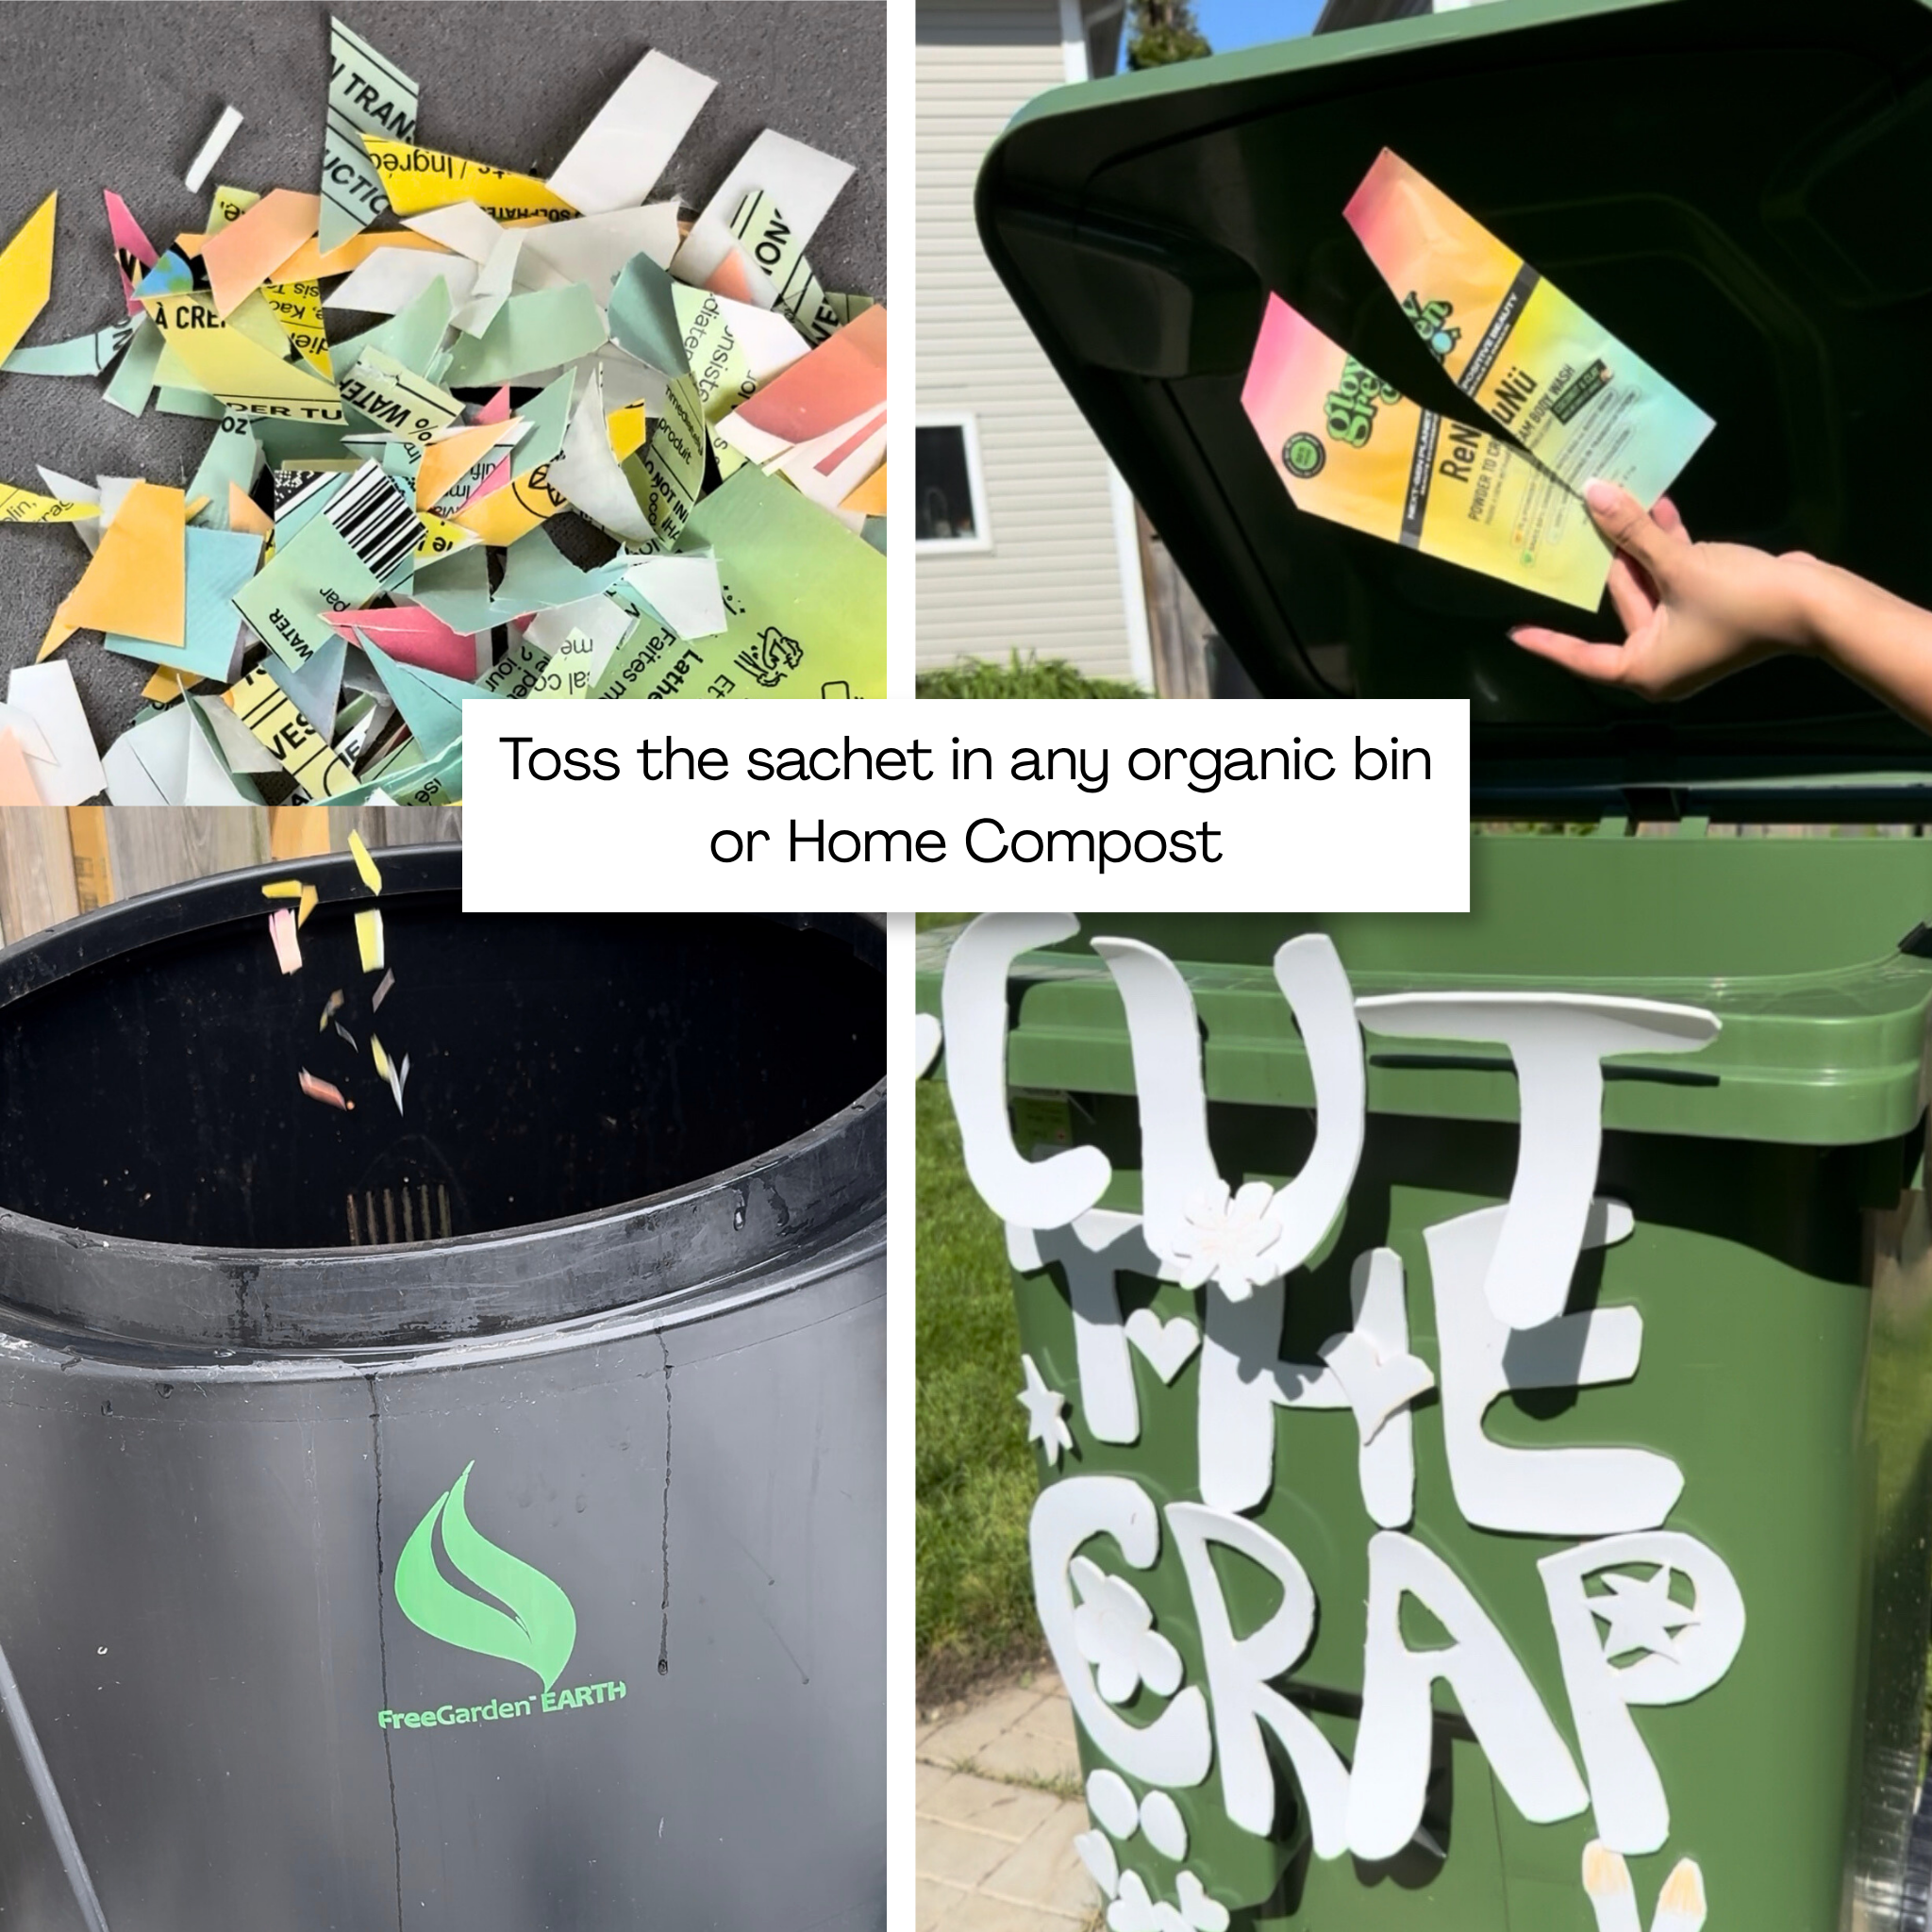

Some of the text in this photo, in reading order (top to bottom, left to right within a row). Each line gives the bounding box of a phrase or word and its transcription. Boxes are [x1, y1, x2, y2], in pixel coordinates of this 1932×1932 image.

[342, 72, 415, 143] TRAN
[175, 305, 227, 330] CRE
[268, 608, 315, 660] WATER
[942, 912, 1721, 1329] CUT
[1004, 1198, 1685, 1536] THE
[1028, 1474, 1746, 1860] CRAP
[377, 1680, 627, 1729] FreeGarden EARTH
